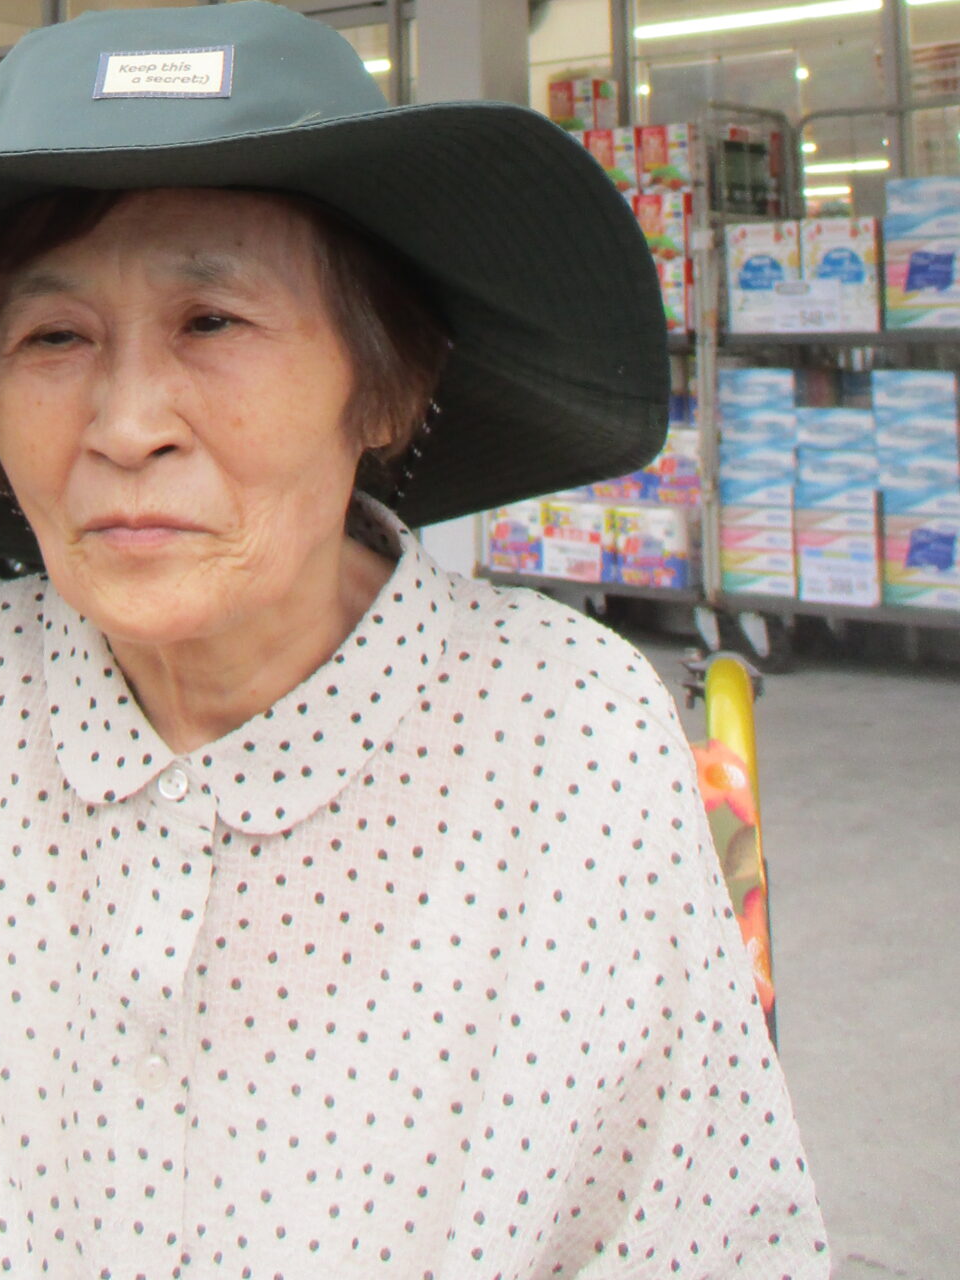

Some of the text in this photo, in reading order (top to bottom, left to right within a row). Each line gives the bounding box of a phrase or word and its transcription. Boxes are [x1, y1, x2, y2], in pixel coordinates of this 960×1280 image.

[118, 61, 192, 74] Keep this
[131, 76, 141, 84] a
